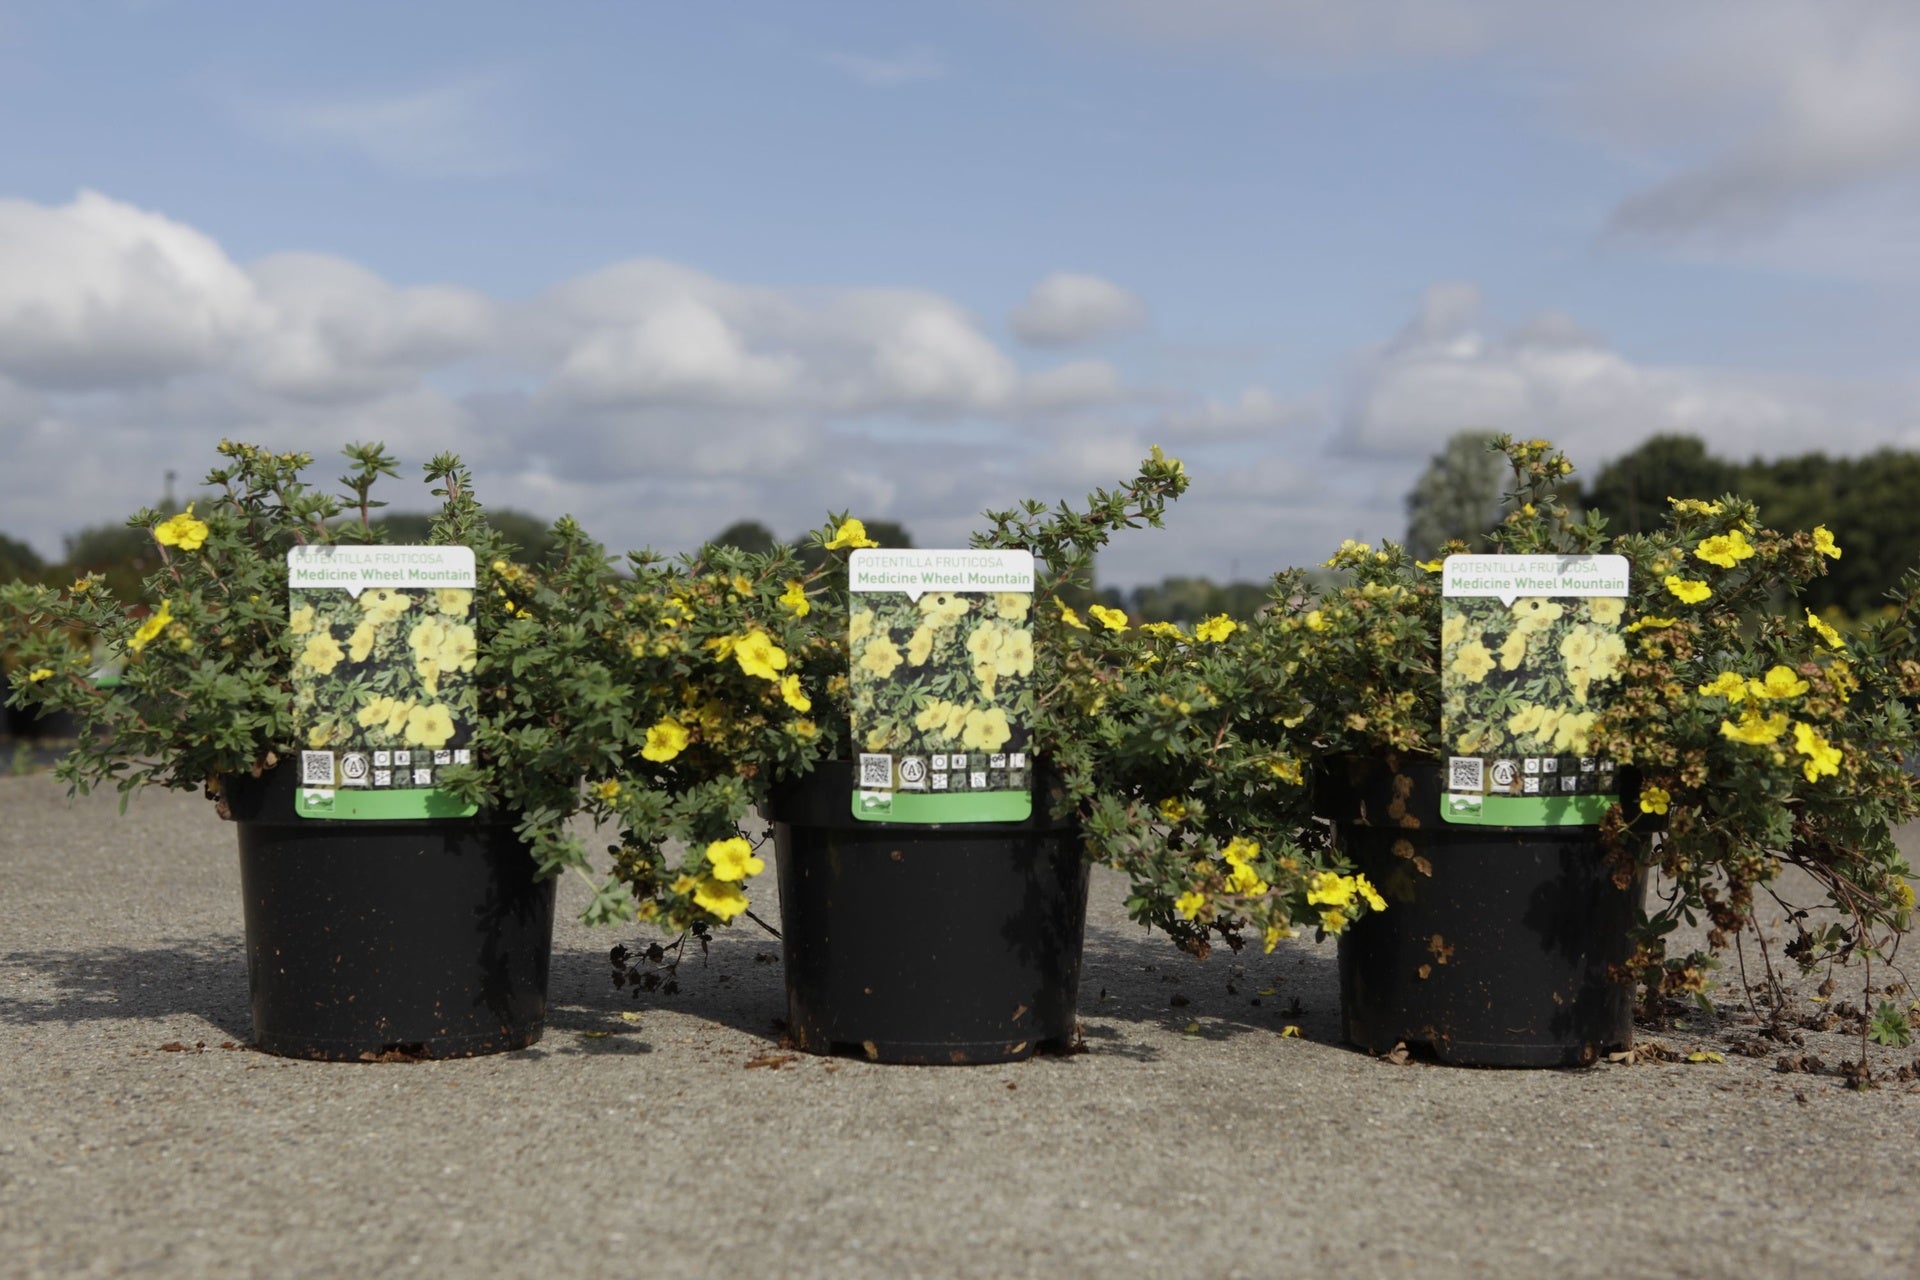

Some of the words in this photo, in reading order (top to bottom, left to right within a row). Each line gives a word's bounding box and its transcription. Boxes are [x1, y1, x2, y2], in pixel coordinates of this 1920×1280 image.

[296, 553, 372, 563] POTENTILLA
[376, 553, 443, 563] FRUTICOSA
[858, 557, 932, 567] POTENTILLA
[936, 557, 1003, 567] FRUTICOSA
[1452, 562, 1527, 573] POTENTILLA
[297, 569, 357, 580] Medicine
[361, 569, 404, 580] Wheel
[409, 569, 470, 580] Mountain
[858, 572, 917, 584] Medicine
[921, 572, 963, 584] Wheel
[968, 572, 1030, 584] Mountain
[1452, 578, 1510, 589] Medicine
[1515, 578, 1558, 589] Wheel
[1562, 578, 1624, 589] Mountain
